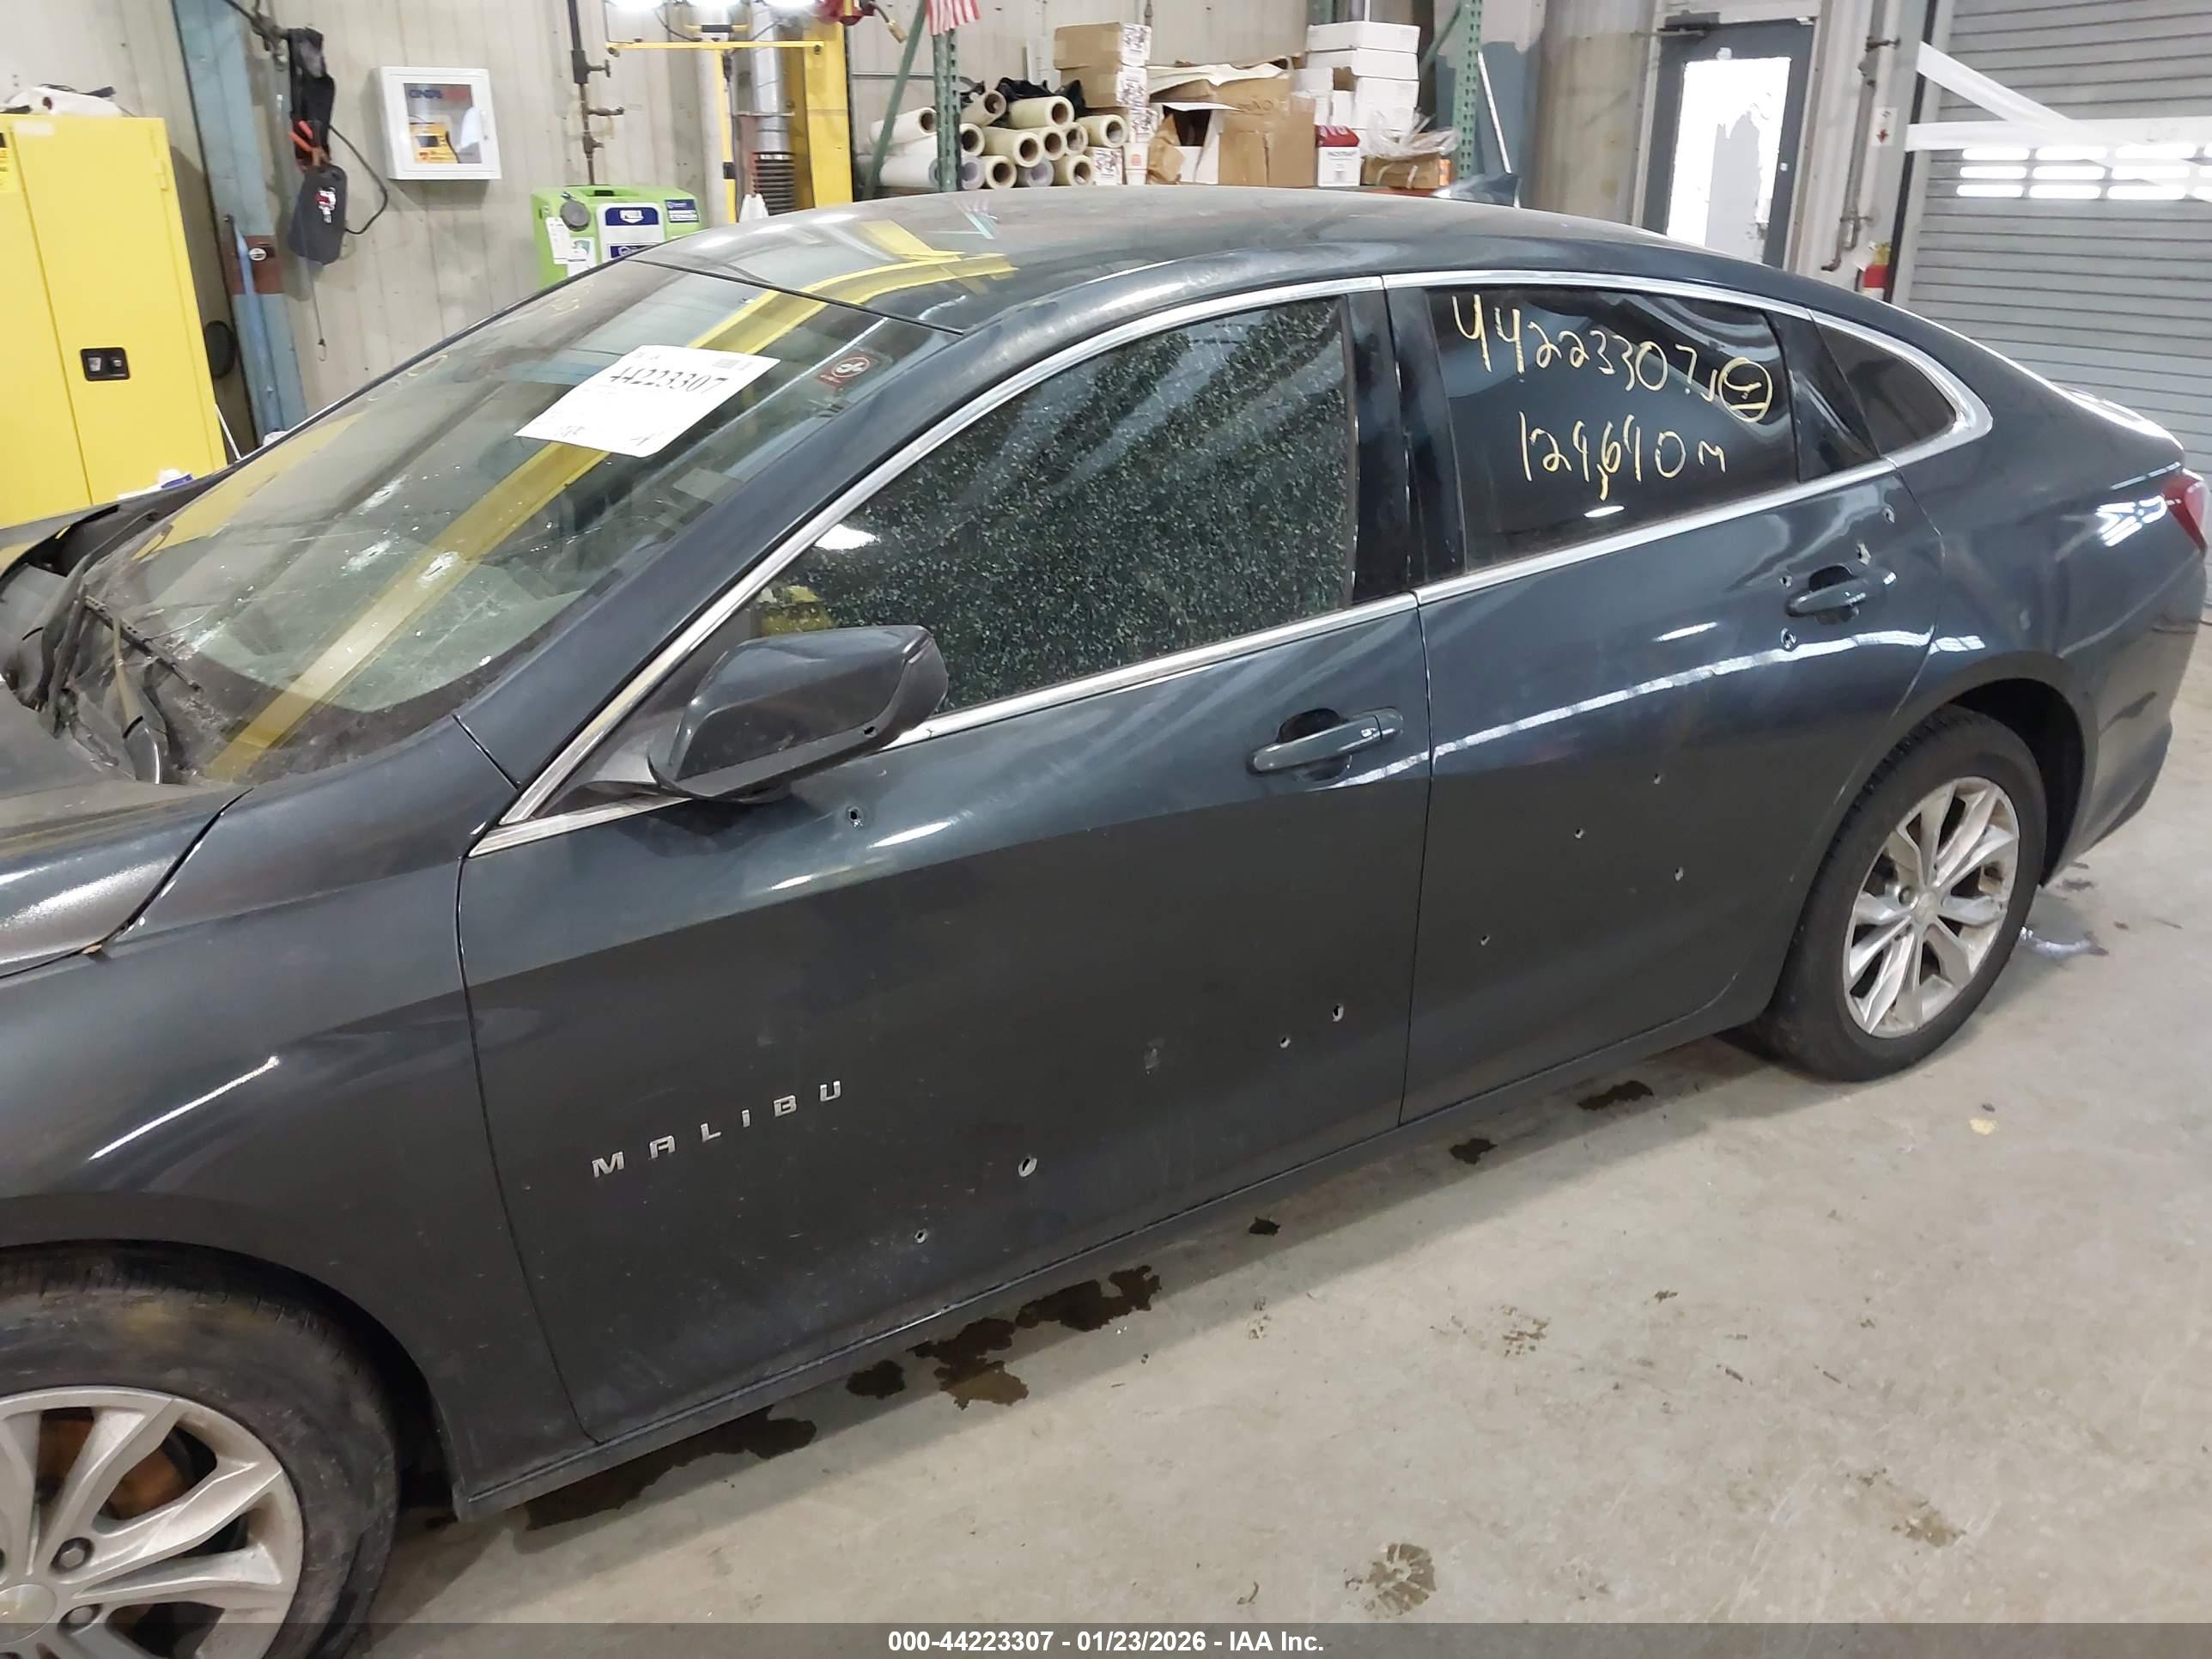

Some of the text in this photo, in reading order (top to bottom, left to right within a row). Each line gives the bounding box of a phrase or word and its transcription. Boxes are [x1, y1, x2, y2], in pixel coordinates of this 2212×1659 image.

[609, 366, 729, 395] 44223307
[1451, 293, 1698, 392] 44223307
[591, 1080, 842, 1178] MALIBU
